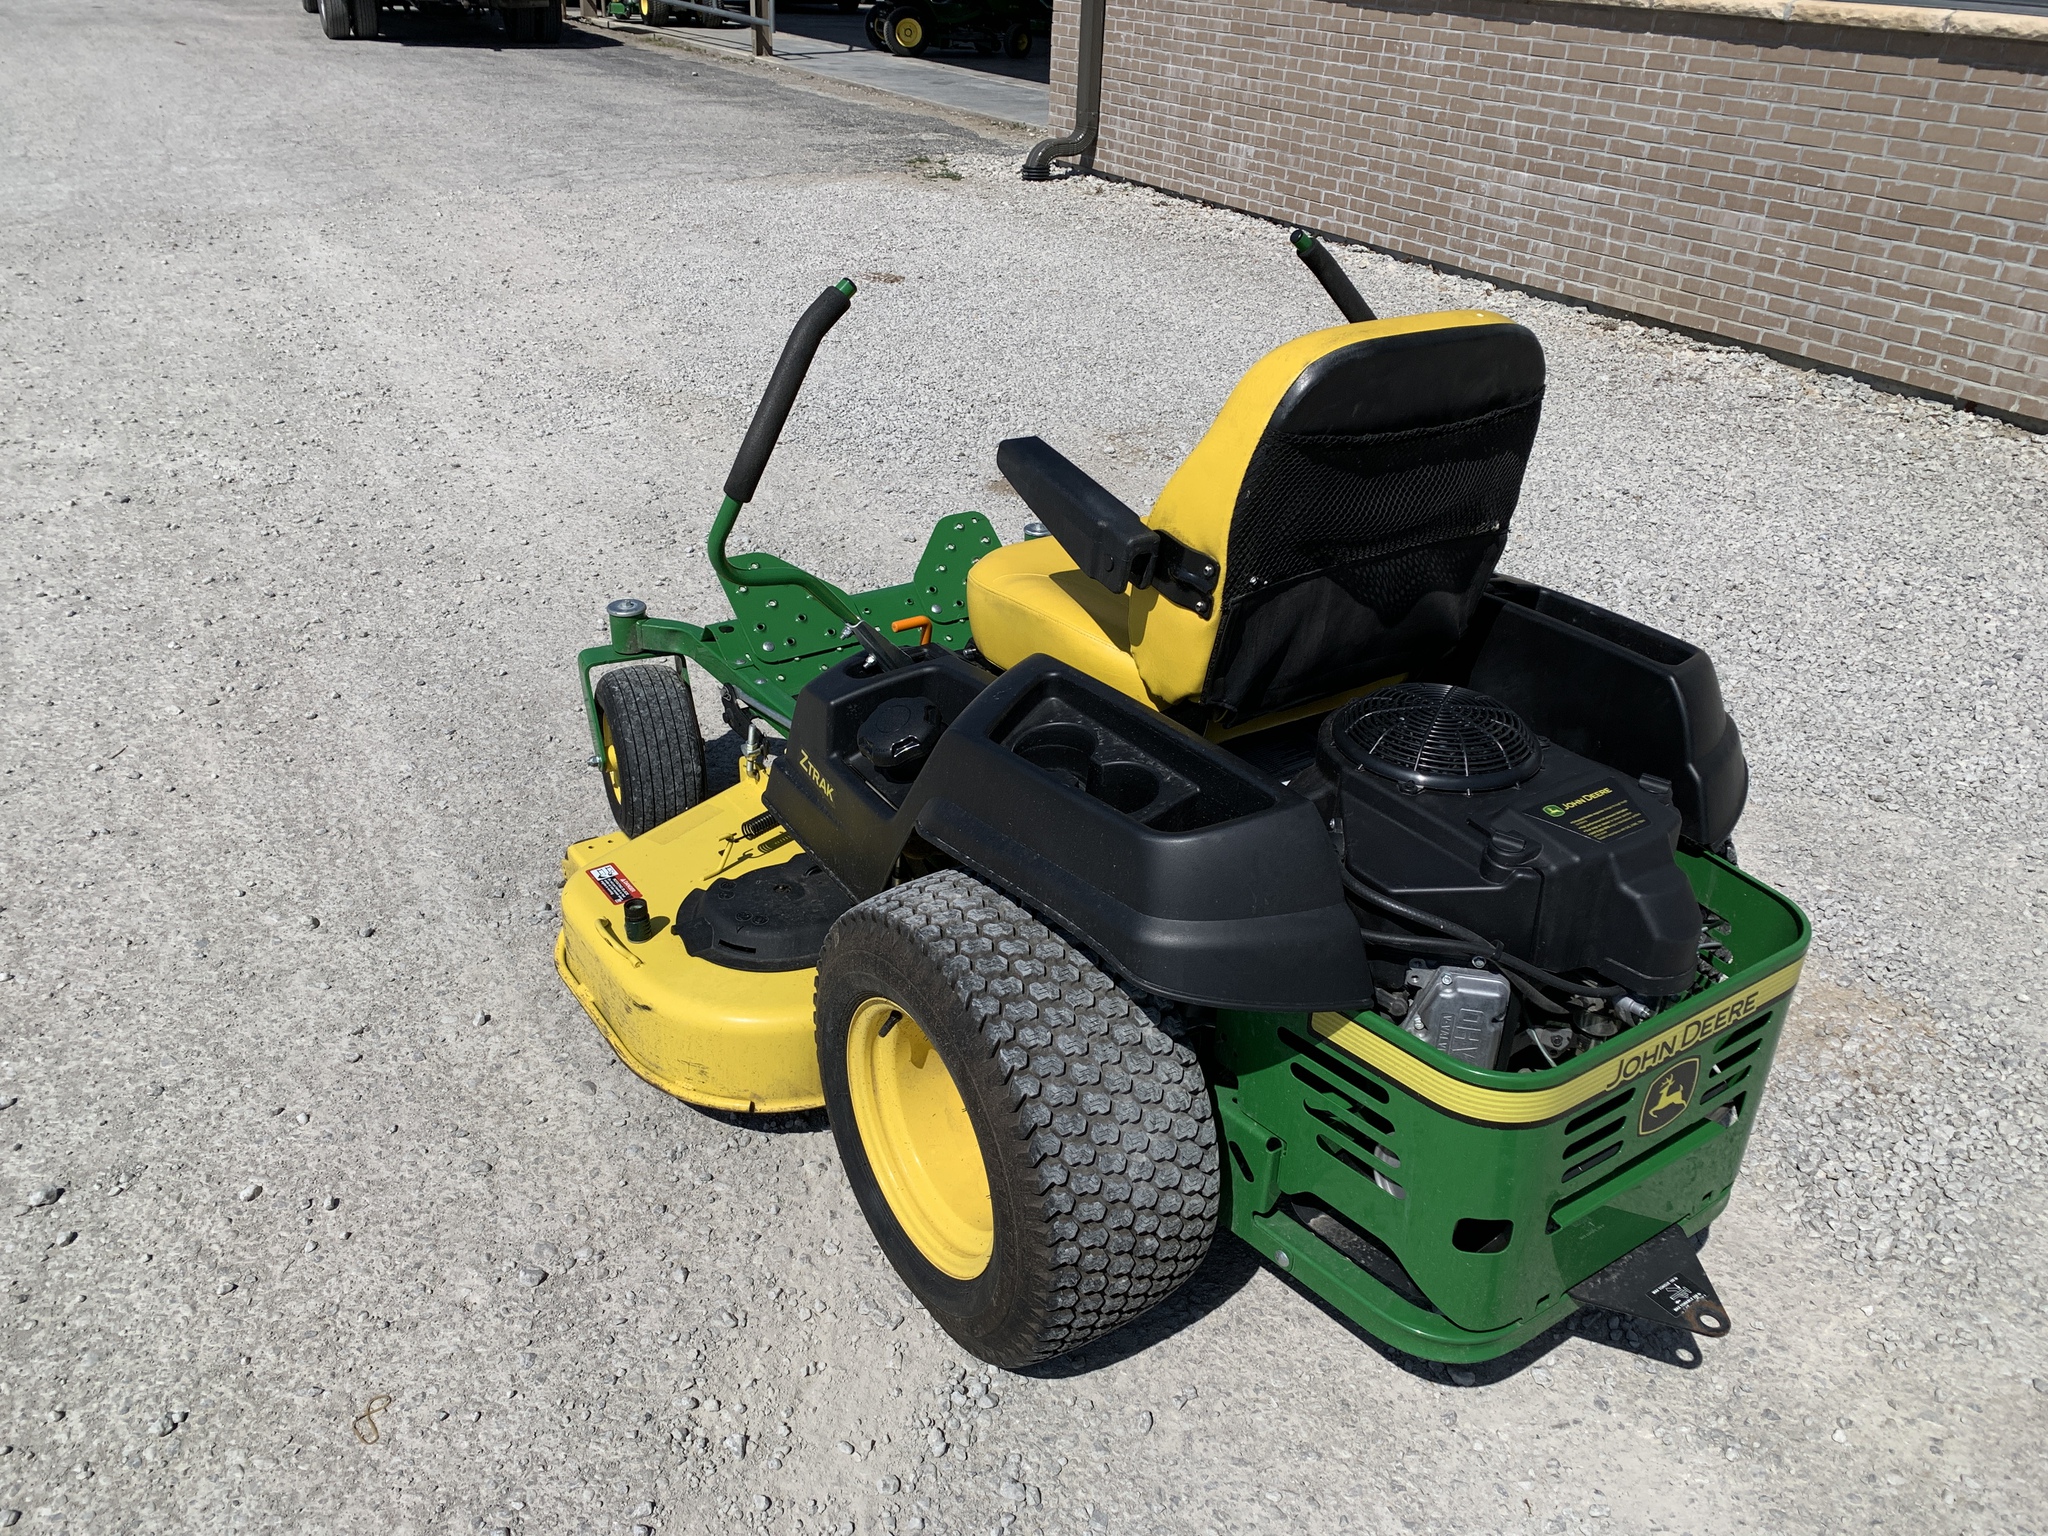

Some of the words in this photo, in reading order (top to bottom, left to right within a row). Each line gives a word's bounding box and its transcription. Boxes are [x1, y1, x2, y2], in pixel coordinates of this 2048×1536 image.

[799, 748, 835, 802] ZTRAK
[1562, 797, 1585, 811] JOHN
[1583, 787, 1613, 803] DEERE
[1606, 1036, 1676, 1089] JOHN
[1681, 991, 1759, 1048] DEERE
